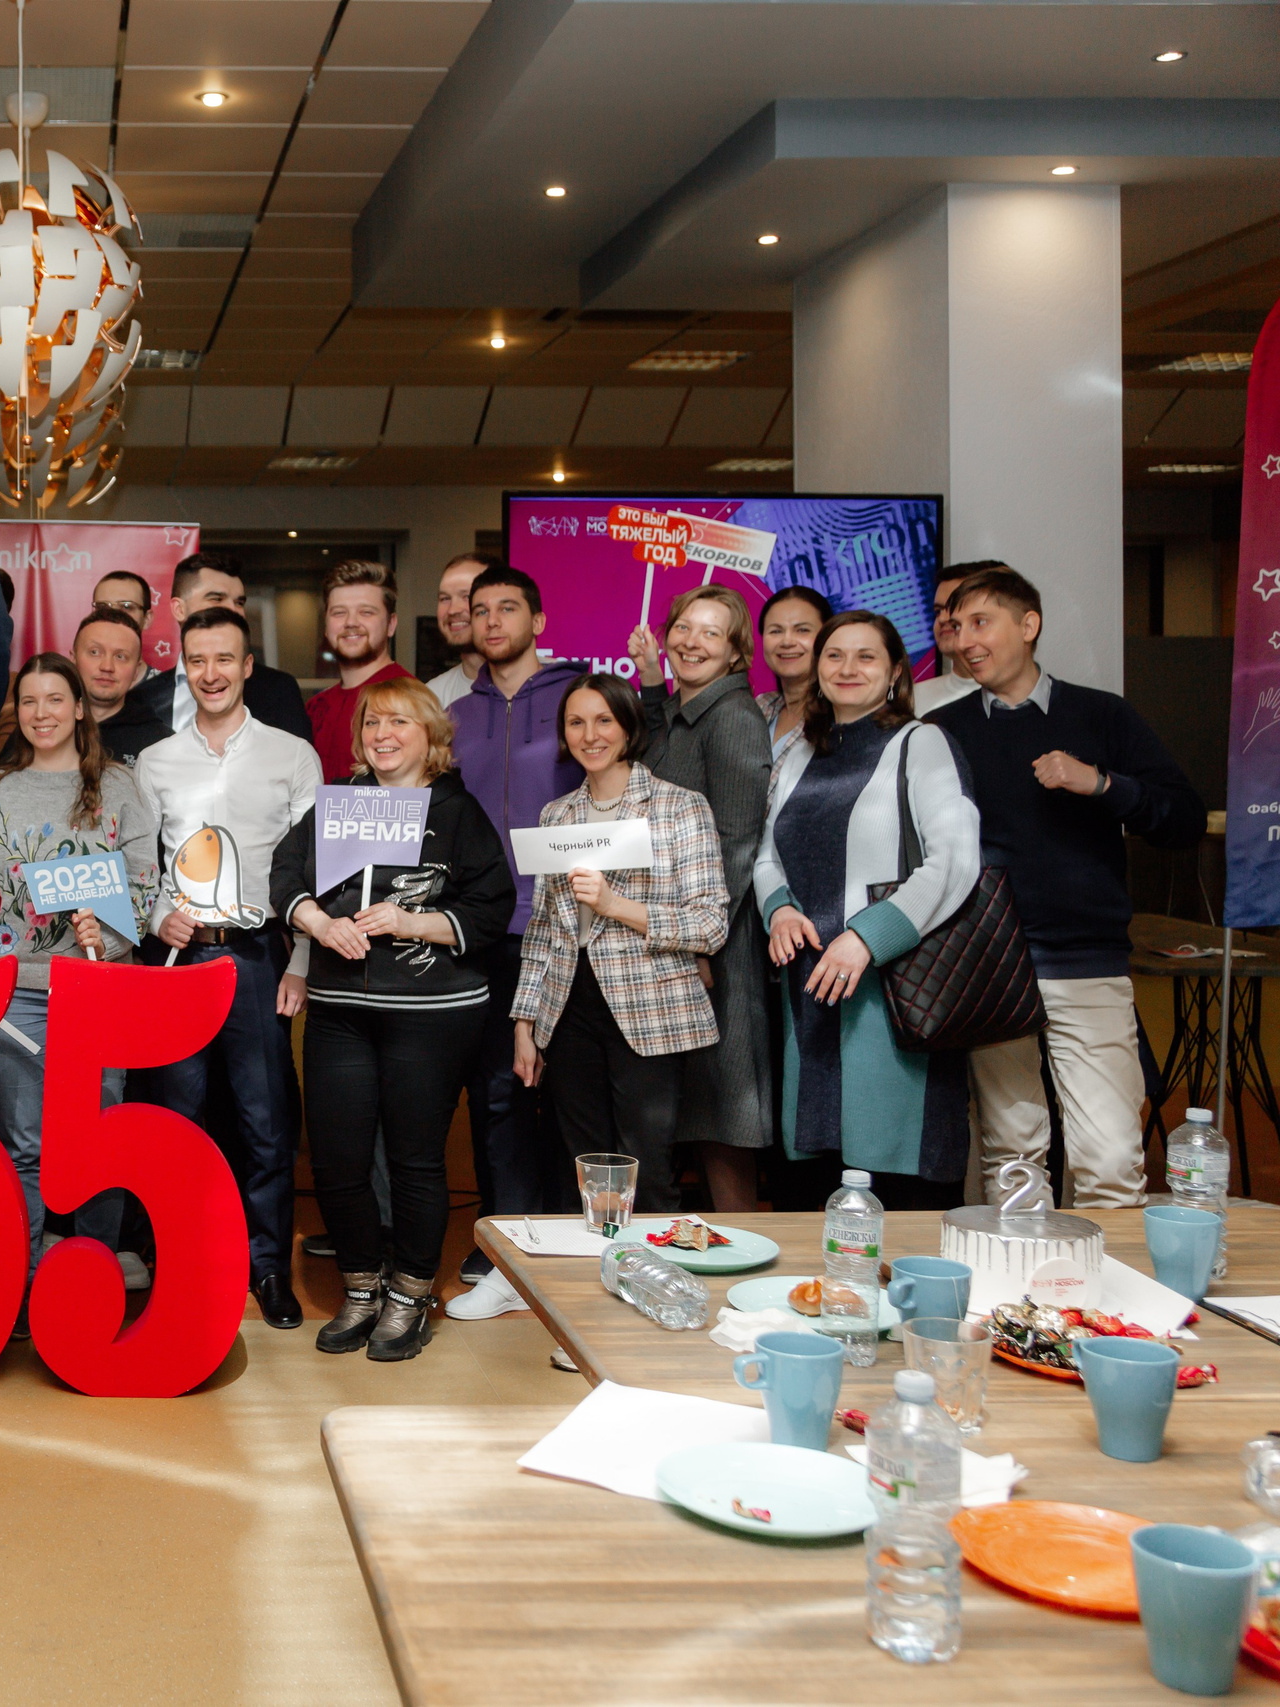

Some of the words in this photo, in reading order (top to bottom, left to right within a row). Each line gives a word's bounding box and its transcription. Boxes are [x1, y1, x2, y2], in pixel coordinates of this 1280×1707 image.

[618, 508, 640, 522] ЭТО
[642, 512, 668, 527] БЫЛ
[610, 524, 688, 545] ТЯЖЕЛЫЙ
[644, 543, 677, 567] ГОД
[683, 543, 763, 571] ЕКОРДОВ
[325, 798, 422, 823] НАШЕ
[1247, 802, 1280, 815] Фаб
[323, 820, 420, 842] ВРЕМЯ
[549, 839, 594, 852] Черный
[597, 838, 612, 848] PR
[34, 859, 124, 895] 2023!
[40, 893, 57, 905] НЕ
[59, 886, 115, 902] ПОДВЕДИ
[828, 1228, 877, 1243] СЕНЕЖСКАЯ
